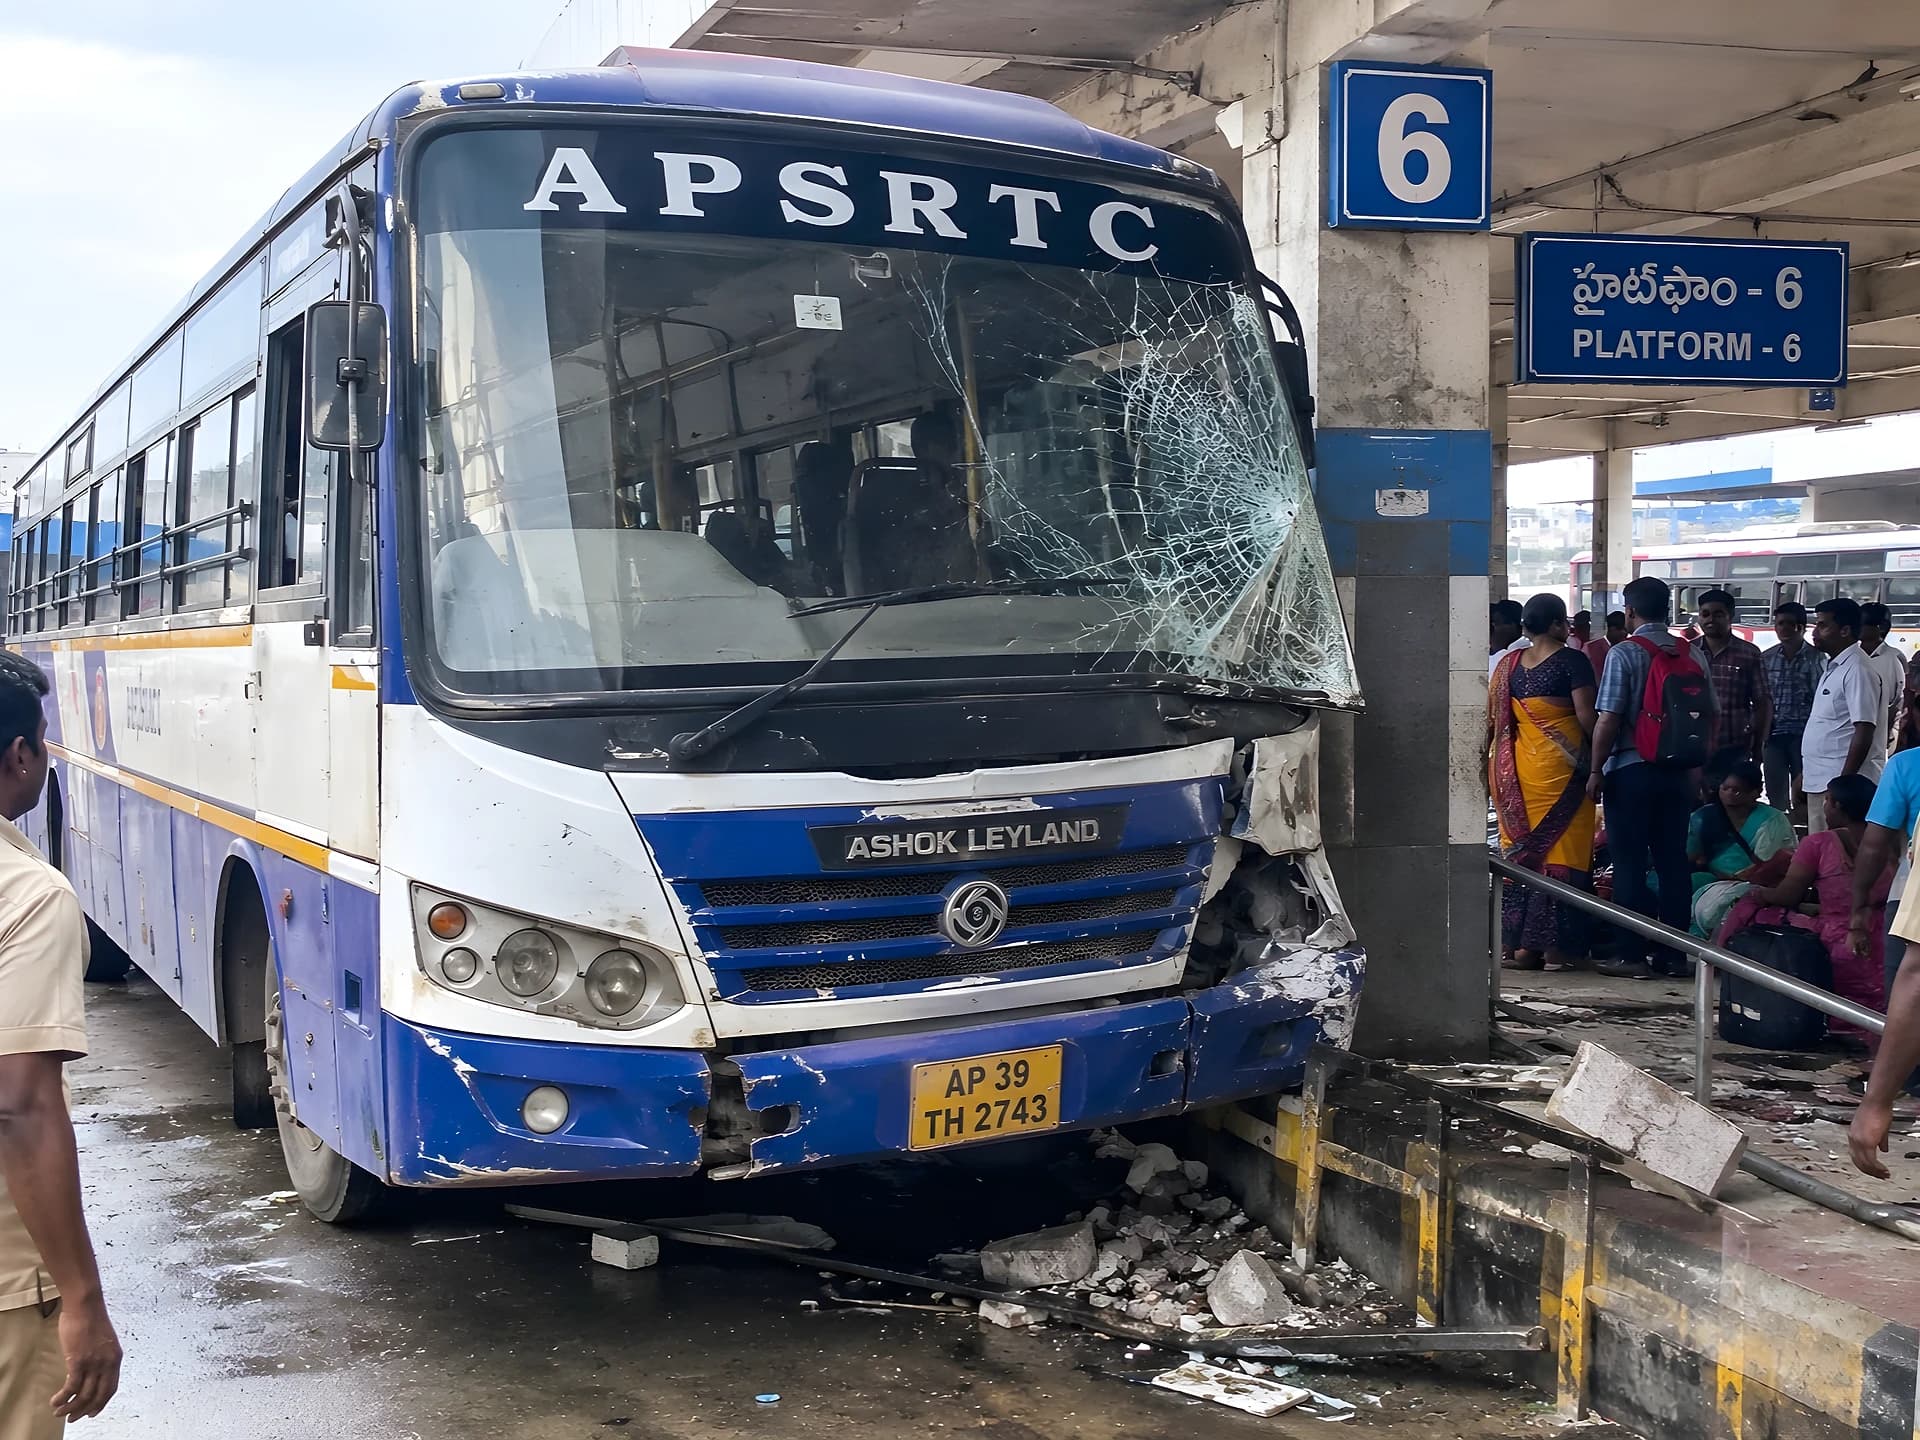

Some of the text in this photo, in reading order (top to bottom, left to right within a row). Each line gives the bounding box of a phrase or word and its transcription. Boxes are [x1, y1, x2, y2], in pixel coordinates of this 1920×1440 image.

[1378, 93, 1451, 203] 6
[523, 147, 1158, 262] APSRTC
[1776, 267, 1802, 309] 6
[1573, 328, 1751, 361] PLATFORM
[1783, 333, 1801, 362] 6
[846, 819, 1100, 860] ASHOK LEYLAND
[944, 1059, 1030, 1099] AP 39
[924, 1094, 1047, 1140] TH 2743
